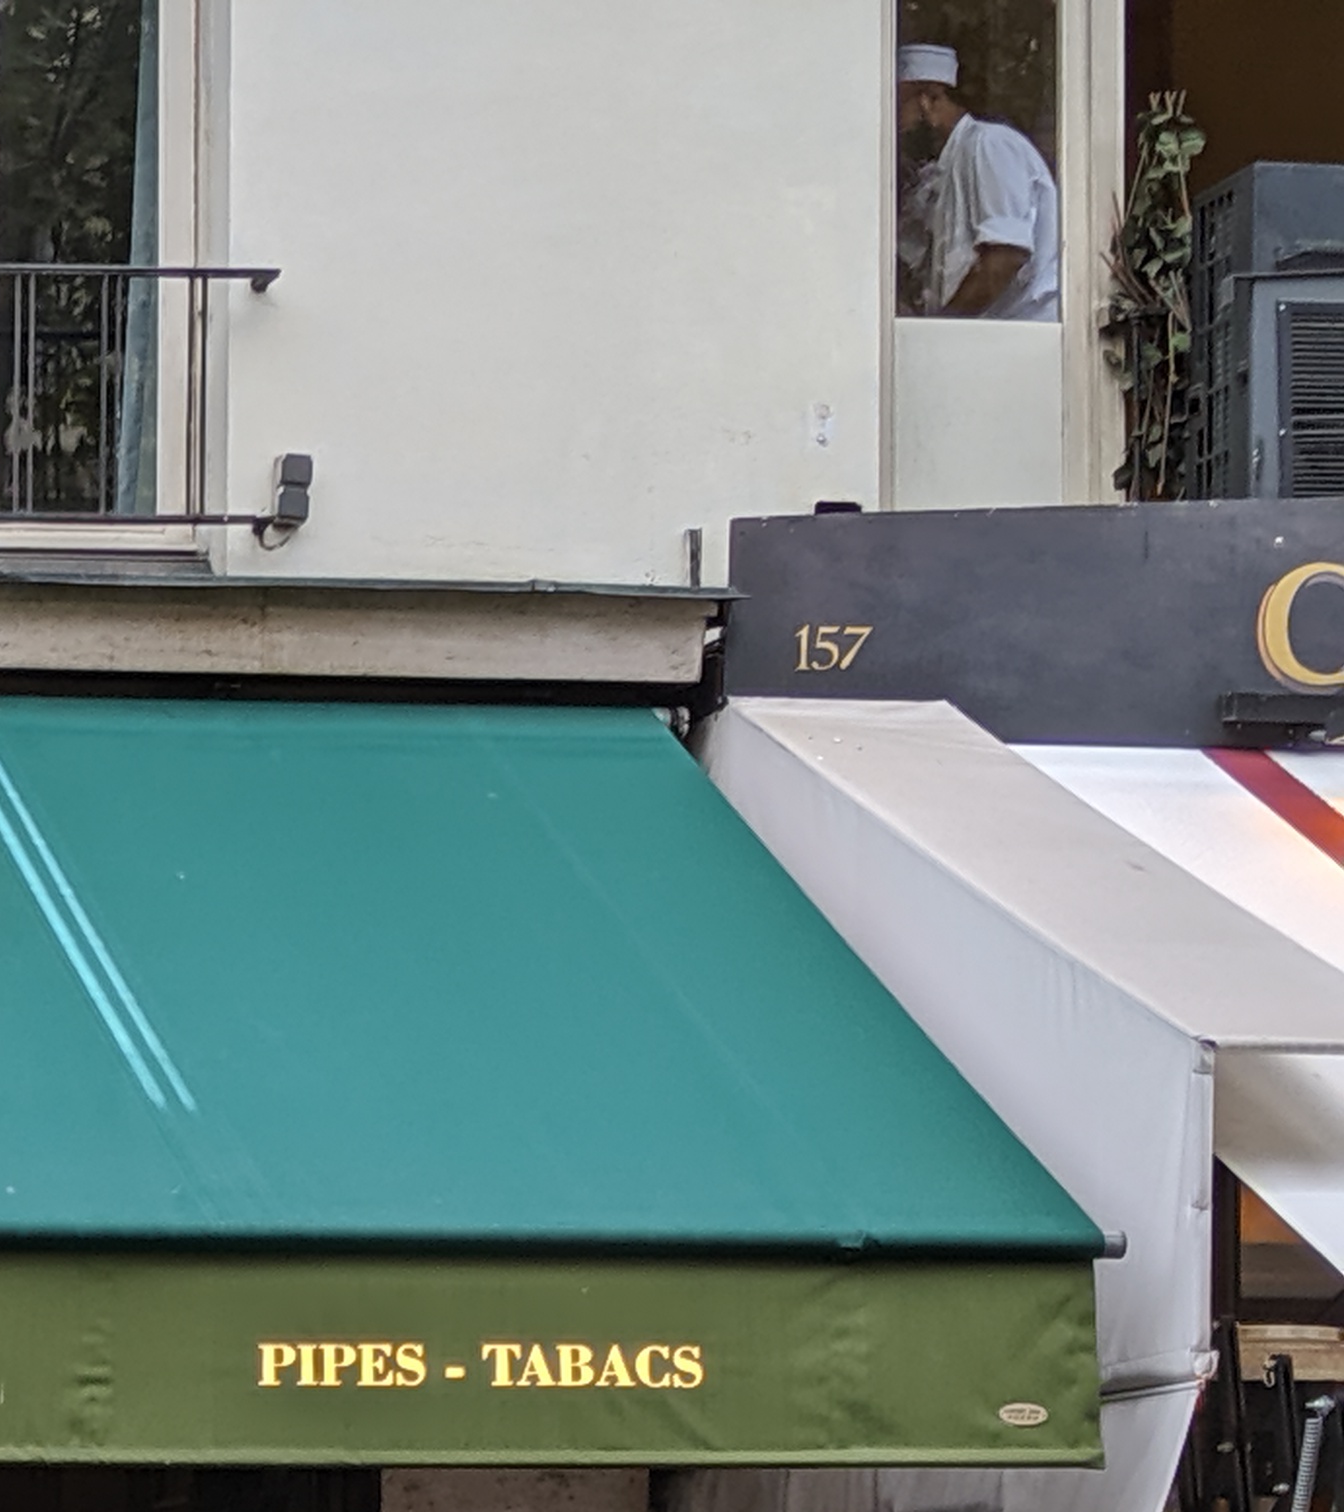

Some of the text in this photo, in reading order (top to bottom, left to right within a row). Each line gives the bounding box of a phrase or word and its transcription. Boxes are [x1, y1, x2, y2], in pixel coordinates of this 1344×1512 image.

[793, 622, 874, 673] 157
[256, 1341, 428, 1389] PIPES
[481, 1342, 705, 1390] TABACS
